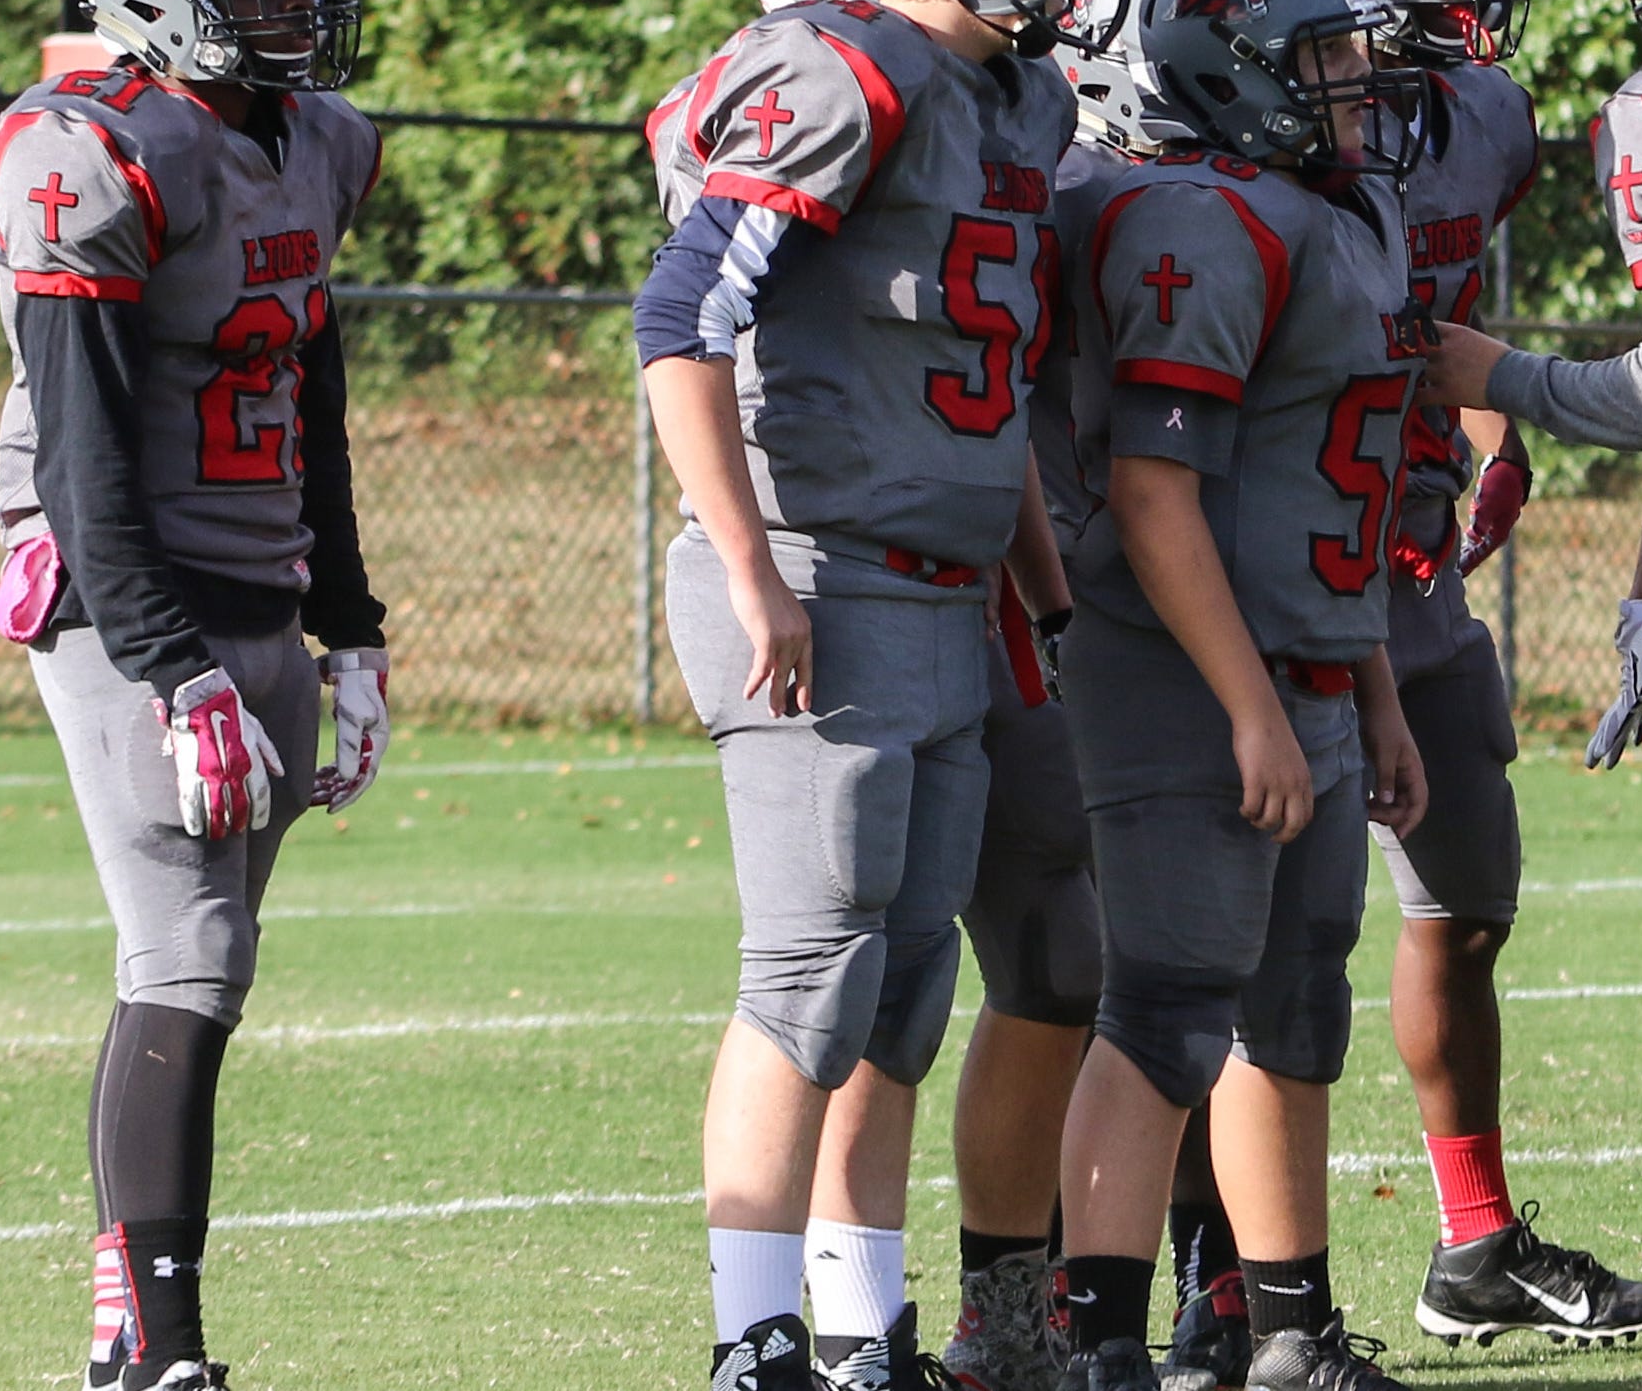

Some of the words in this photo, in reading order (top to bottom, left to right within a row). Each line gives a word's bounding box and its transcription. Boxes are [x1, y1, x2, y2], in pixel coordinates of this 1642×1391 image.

[242, 228, 322, 287] LIONS
[1308, 368, 1412, 597] 5
[760, 1340, 797, 1362] adidas
